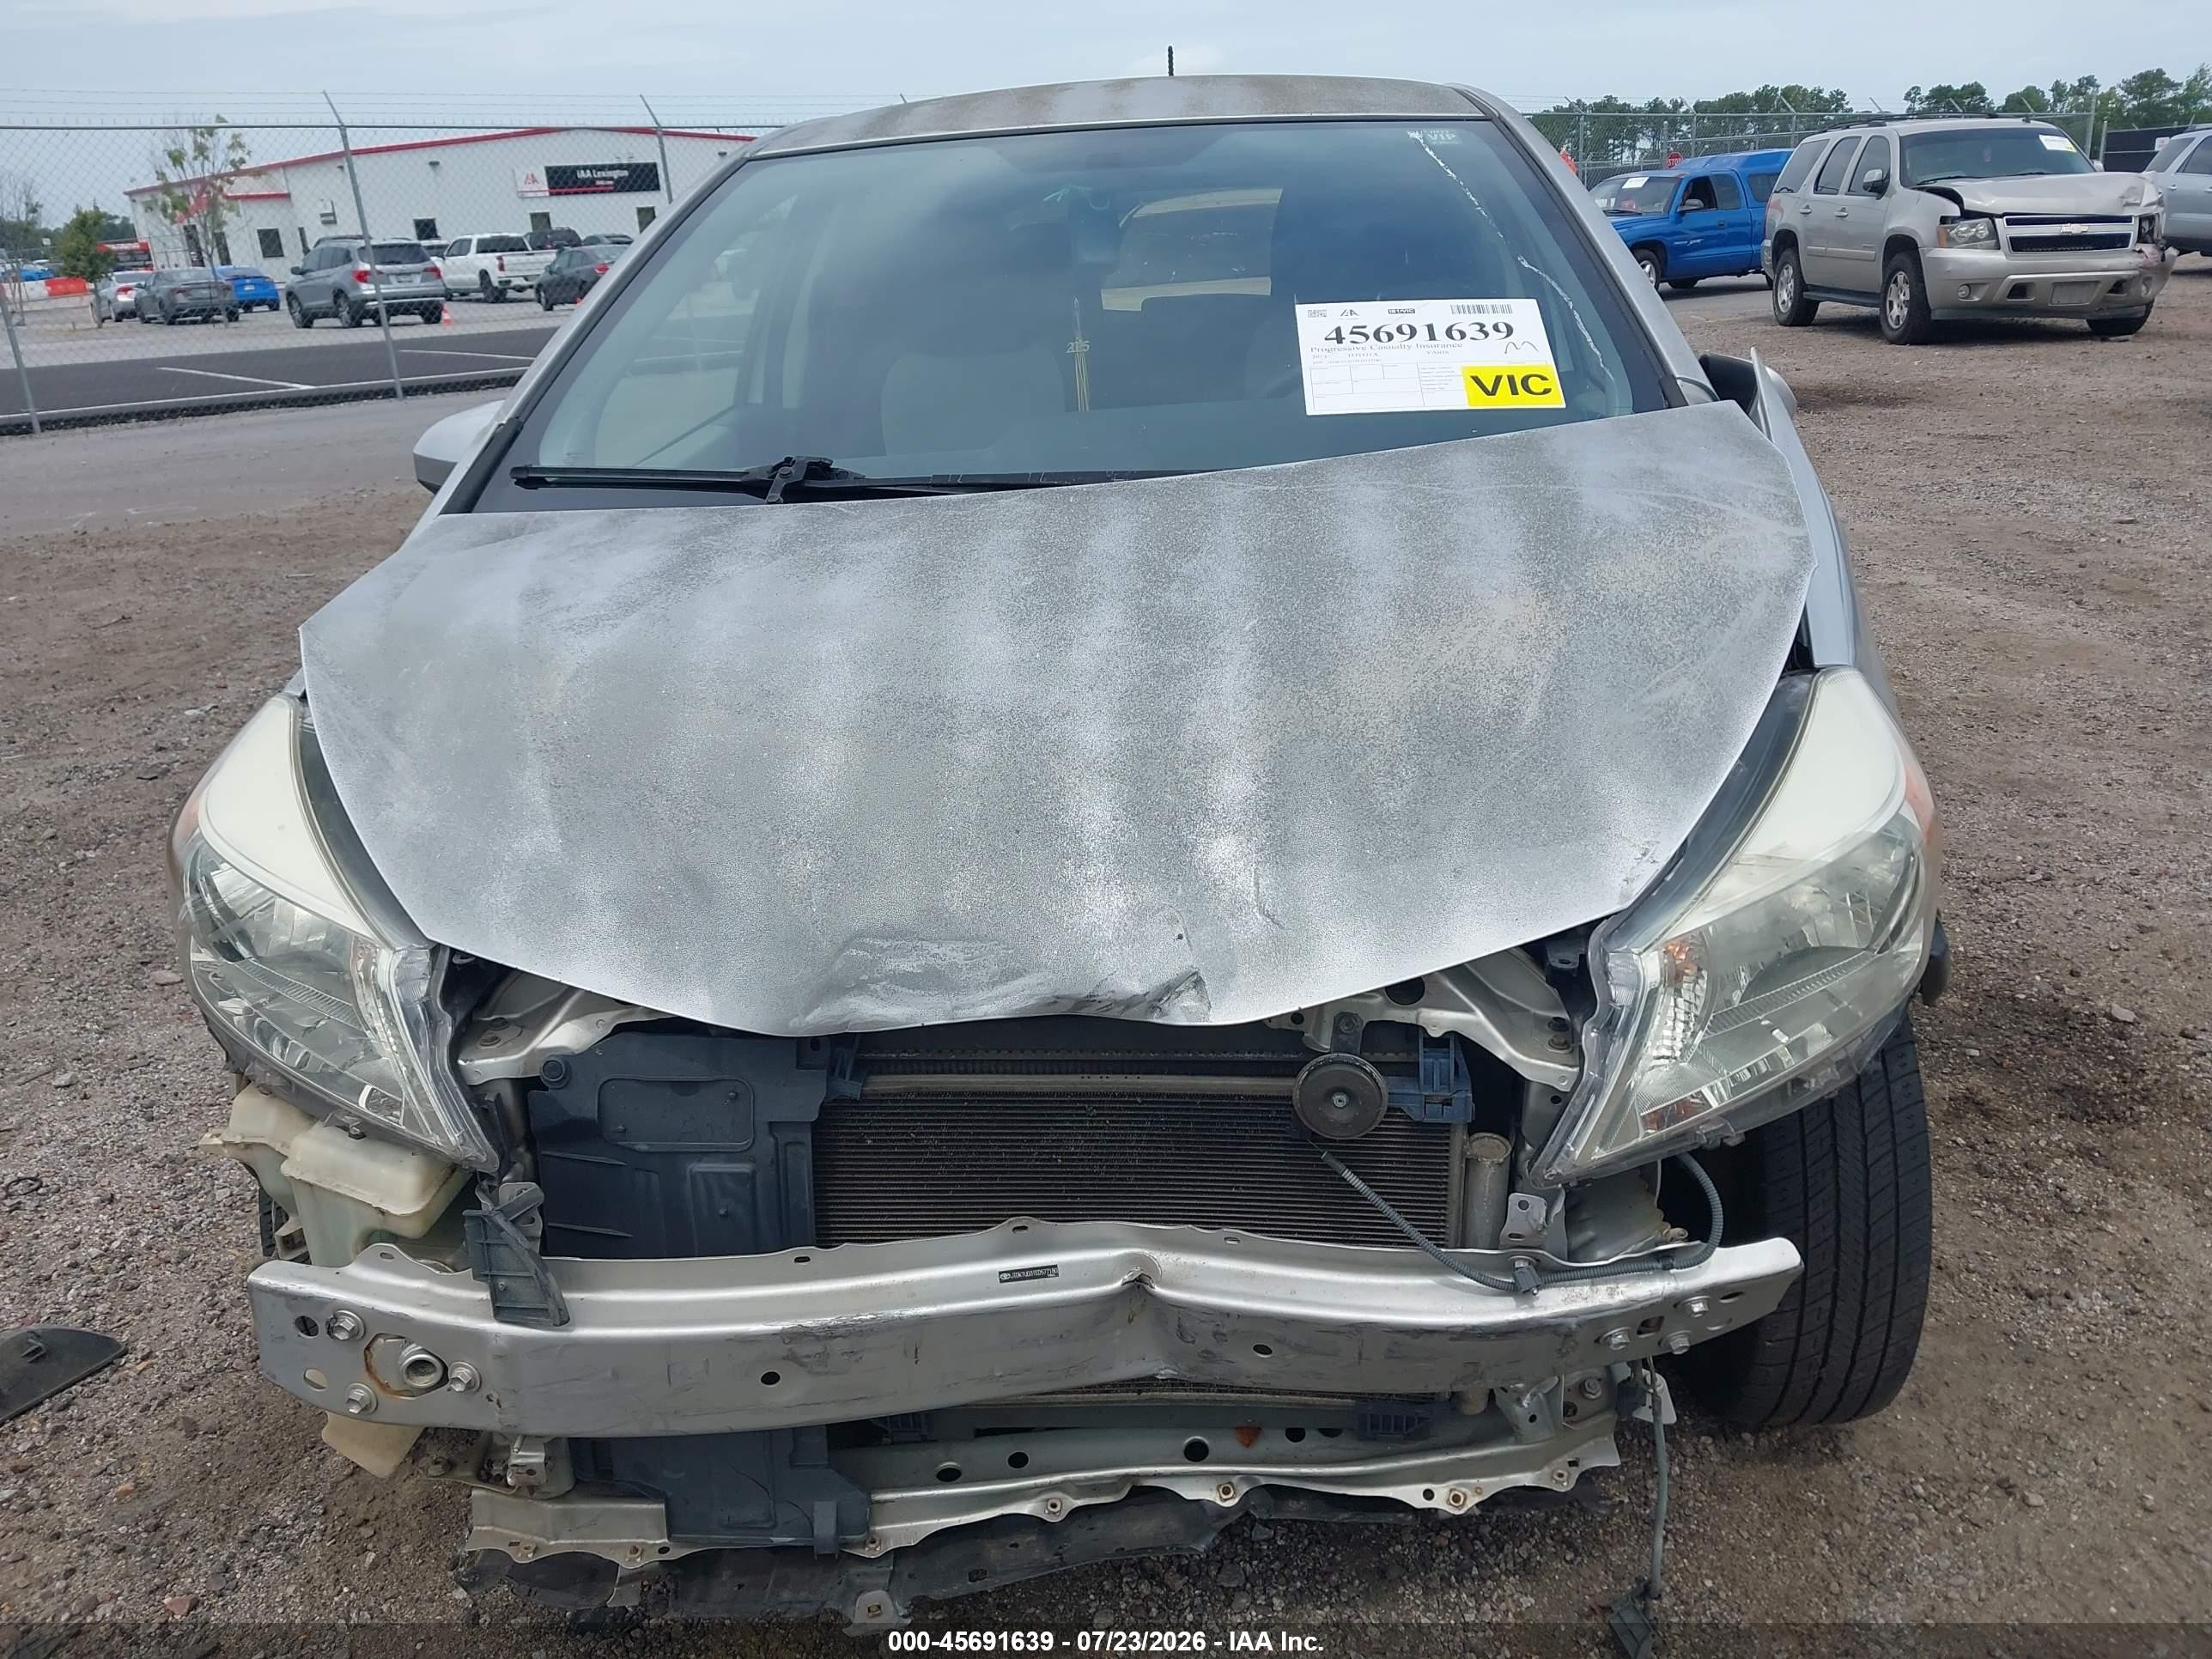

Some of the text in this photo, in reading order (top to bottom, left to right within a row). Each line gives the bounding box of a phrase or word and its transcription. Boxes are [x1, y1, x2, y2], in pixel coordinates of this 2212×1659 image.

[576, 170, 592, 179] IAA
[1324, 321, 1514, 344] 45691639
[1310, 342, 1463, 354] Progressive Casualty Insurance
[1469, 374, 1553, 397] VIC
